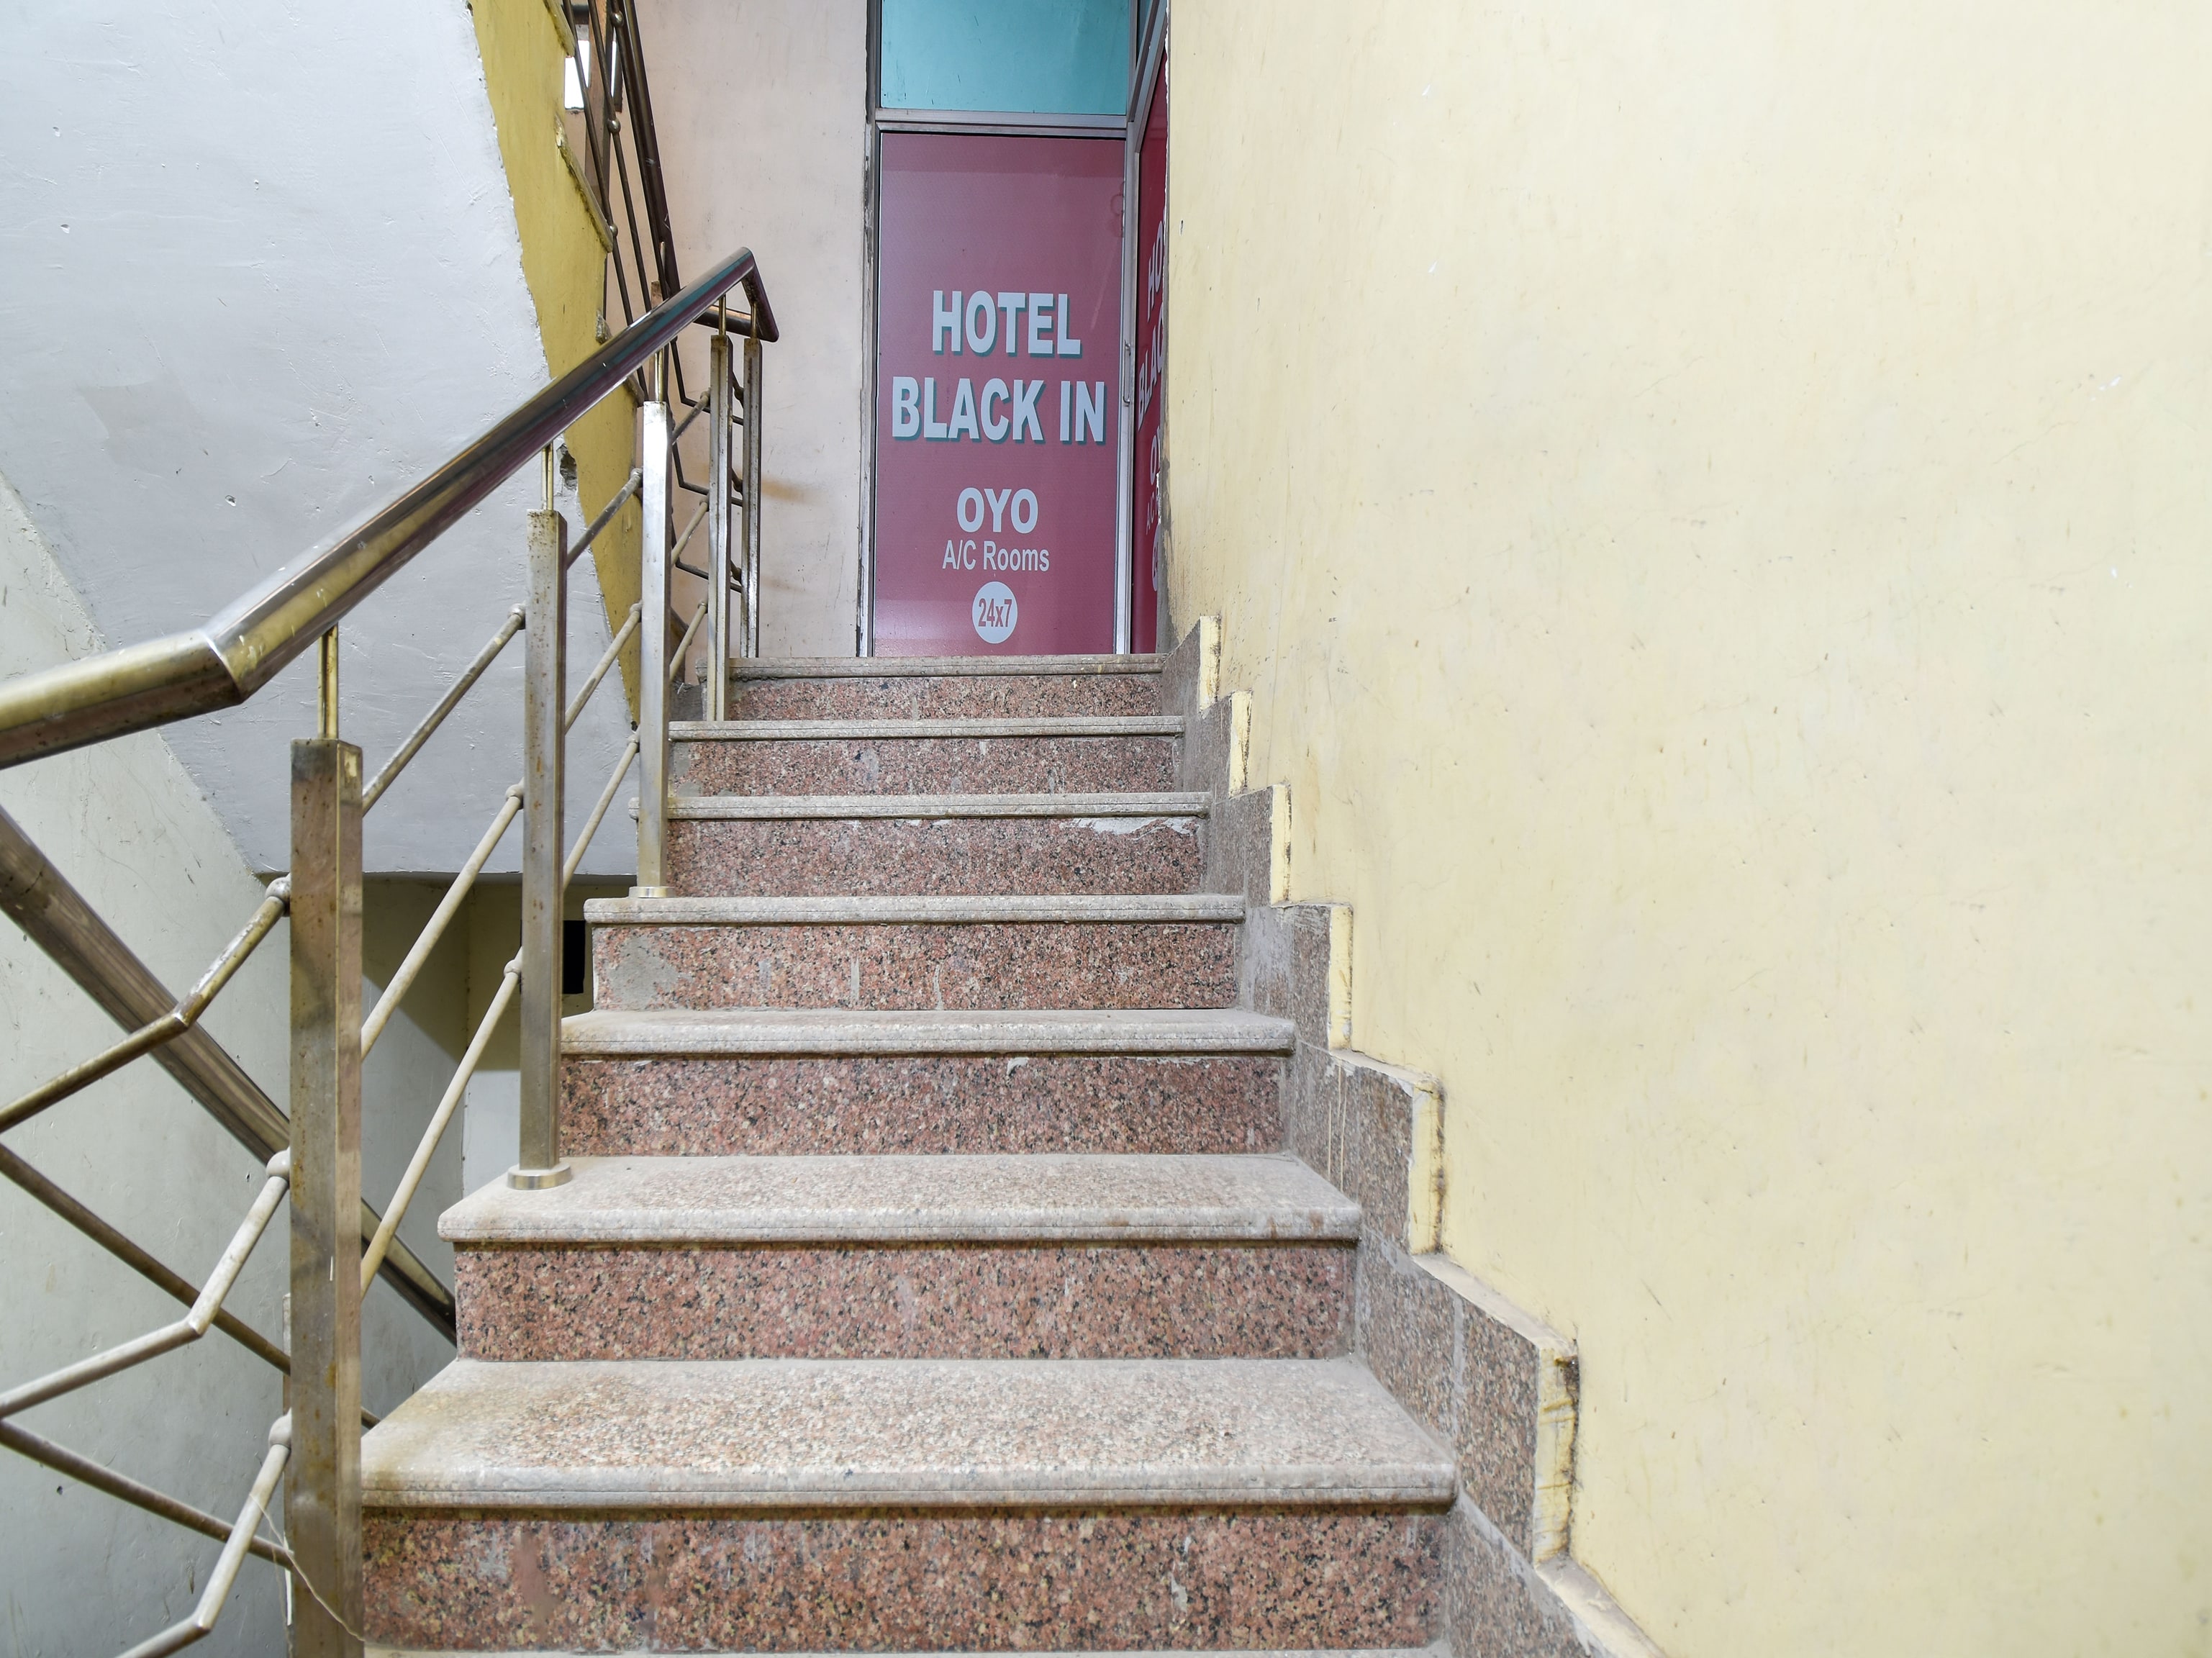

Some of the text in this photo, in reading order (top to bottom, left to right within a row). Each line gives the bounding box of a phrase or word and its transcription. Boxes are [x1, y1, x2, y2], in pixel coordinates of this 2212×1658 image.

[932, 290, 1082, 356] HOTEL
[892, 376, 1105, 443] BLACK IN
[956, 487, 1038, 534] OYO
[942, 540, 1050, 571] A/C Rooms
[978, 598, 1012, 628] 24x7
